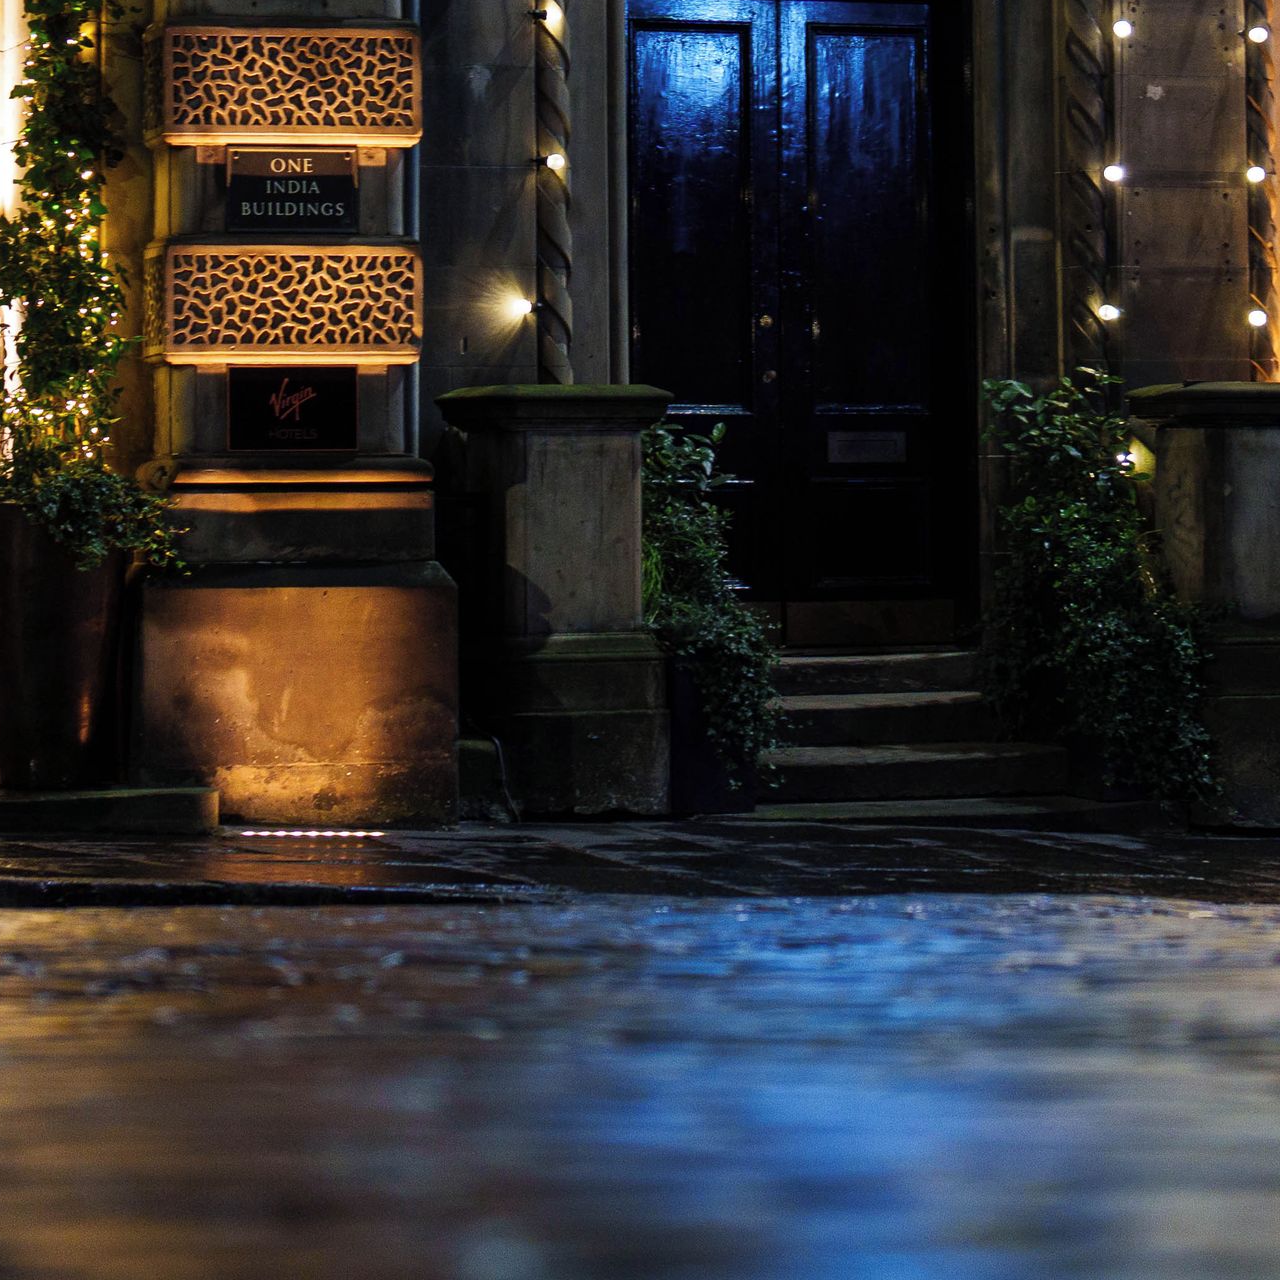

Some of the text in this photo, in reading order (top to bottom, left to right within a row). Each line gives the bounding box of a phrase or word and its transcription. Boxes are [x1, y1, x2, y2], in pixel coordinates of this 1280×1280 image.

[269, 157, 315, 174] ONE
[265, 179, 321, 195] INDIA
[240, 201, 346, 217] BUILDINGS
[269, 377, 318, 422] Virgin
[268, 427, 320, 440] HOTELS
